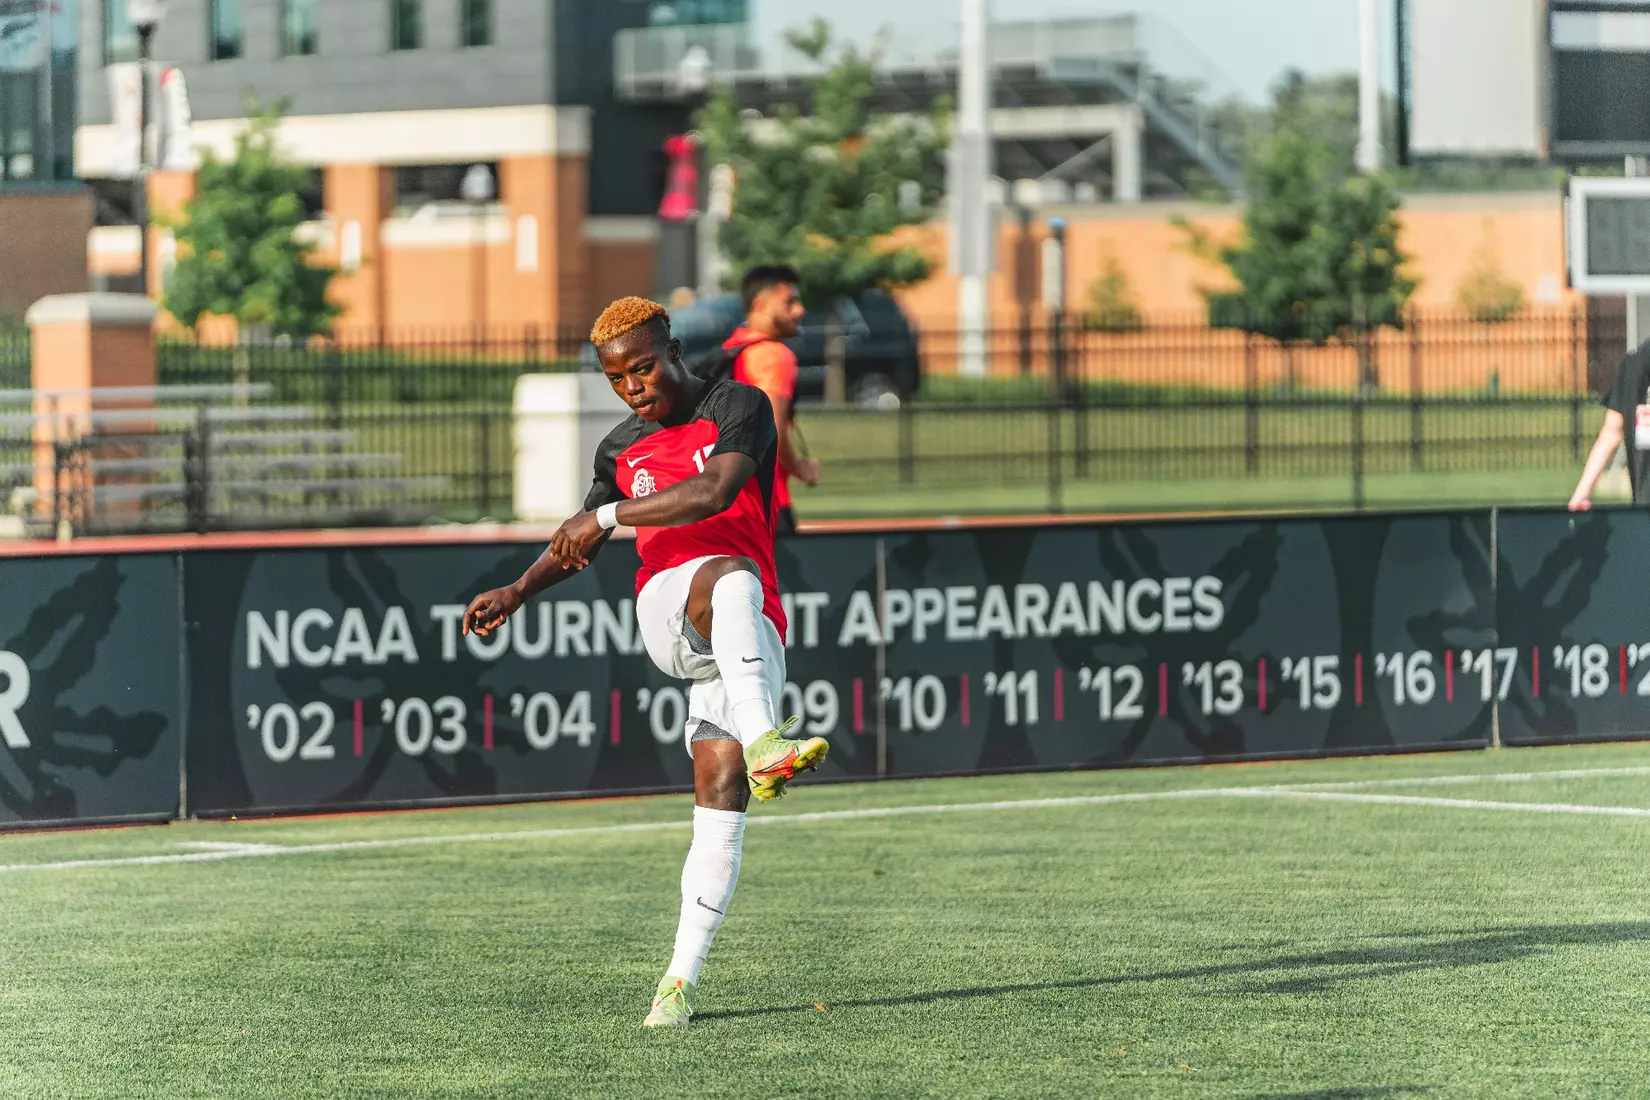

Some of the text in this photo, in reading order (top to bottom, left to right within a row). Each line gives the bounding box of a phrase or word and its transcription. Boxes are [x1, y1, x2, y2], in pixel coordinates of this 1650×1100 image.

[246, 575, 1225, 669] NCAA TOURNT APPEARANCES
[246, 701, 335, 762] '02
[380, 695, 467, 756] '03
[510, 690, 596, 750] '04
[879, 674, 947, 731] '10
[983, 669, 1039, 726] '11
[1079, 664, 1144, 721] '12
[1182, 659, 1245, 715] '13
[1281, 654, 1342, 710] '15
[1374, 649, 1436, 705] '16
[1460, 647, 1519, 702] '17
[1553, 643, 1610, 698] '18
